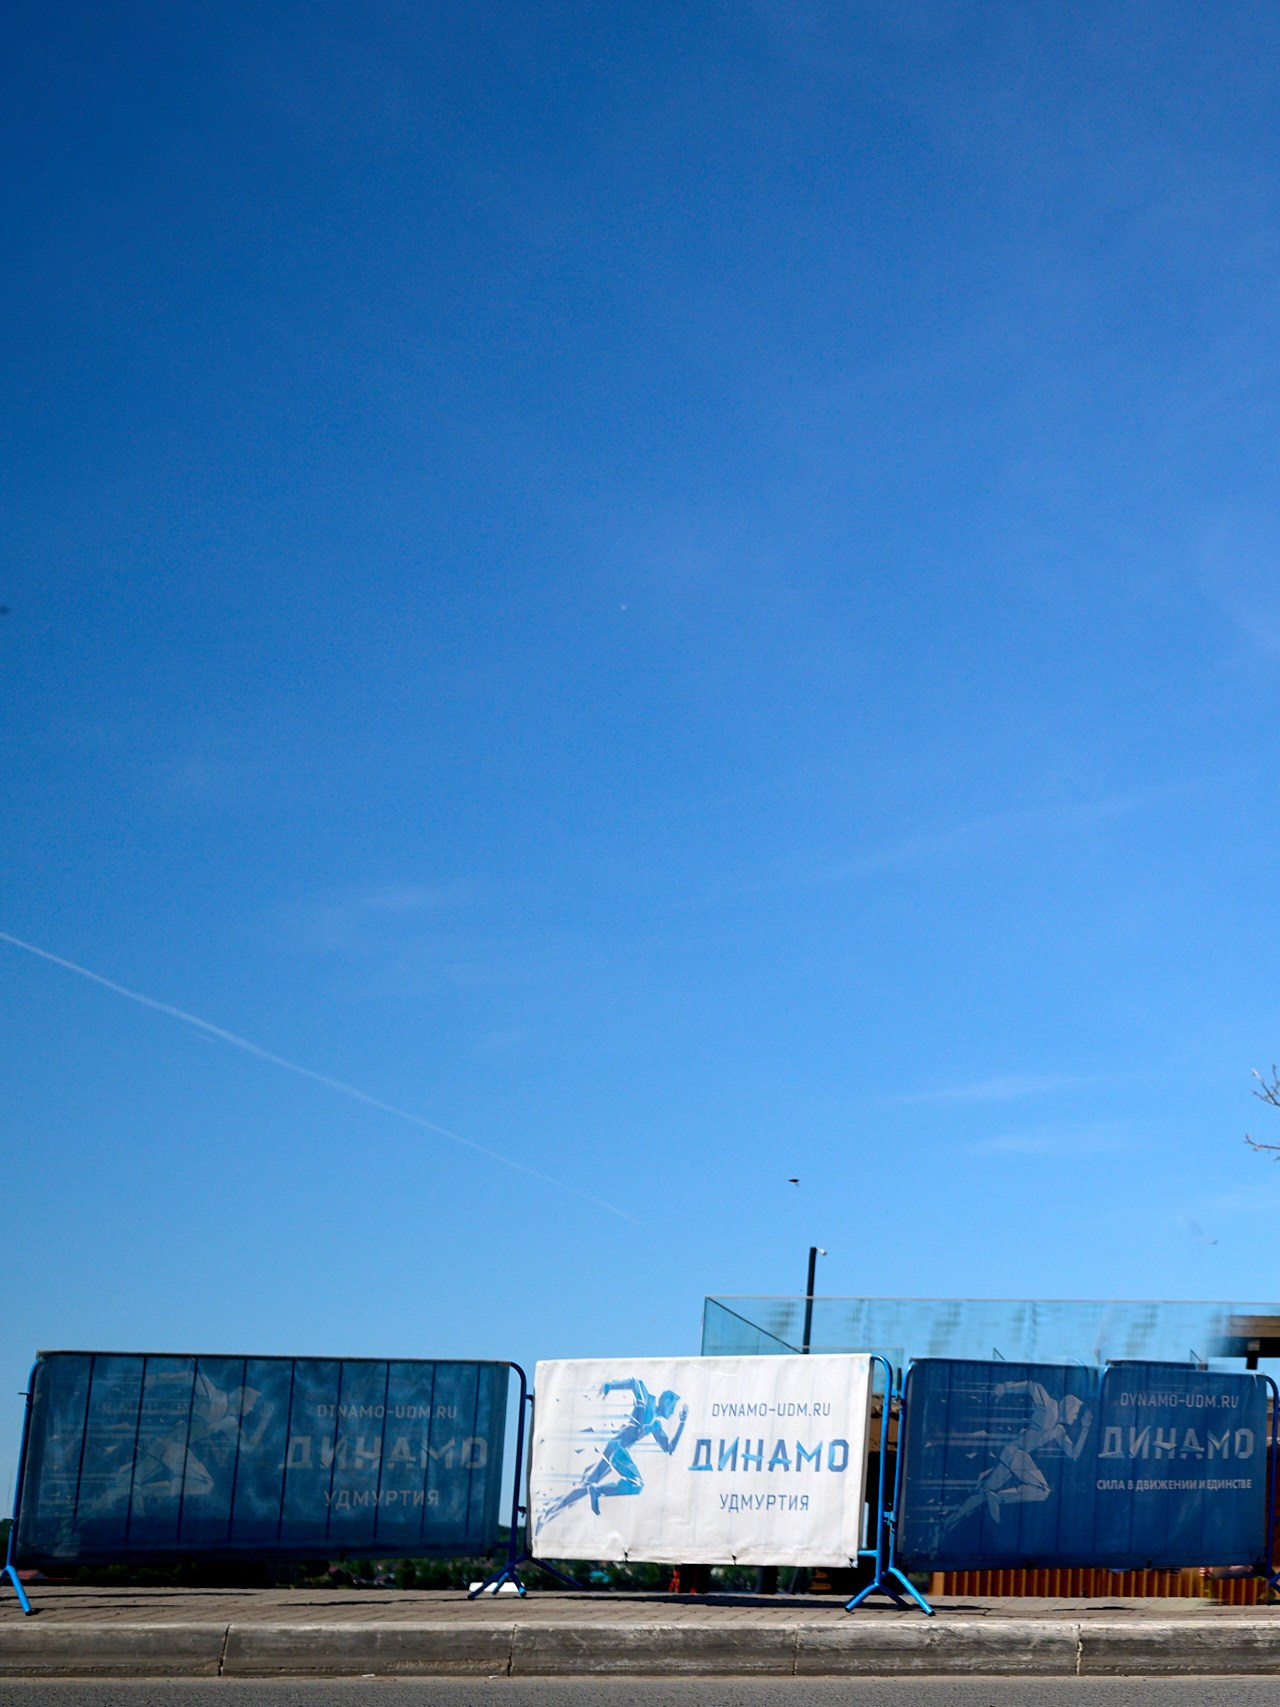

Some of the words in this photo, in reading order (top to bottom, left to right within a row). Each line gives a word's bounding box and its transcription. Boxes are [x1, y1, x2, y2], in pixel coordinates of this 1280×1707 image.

[711, 1402, 831, 1418] DYNAMO-UDM.RU
[1120, 1392, 1240, 1409] DYNAMO-UDM.RU
[277, 1435, 488, 1470] ДИНАМО
[1097, 1425, 1255, 1460] ДИНАМО
[688, 1436, 849, 1473] ДИНАМО
[1096, 1479, 1125, 1490] СИЛА
[1128, 1480, 1134, 1490] В
[1135, 1479, 1198, 1491] ДВИЖЕНИИ
[1207, 1479, 1253, 1491] ЕДИНСТВЕ
[324, 1489, 440, 1510] УДМУРТИЯ
[719, 1493, 809, 1513] УДМУРТИЯ
